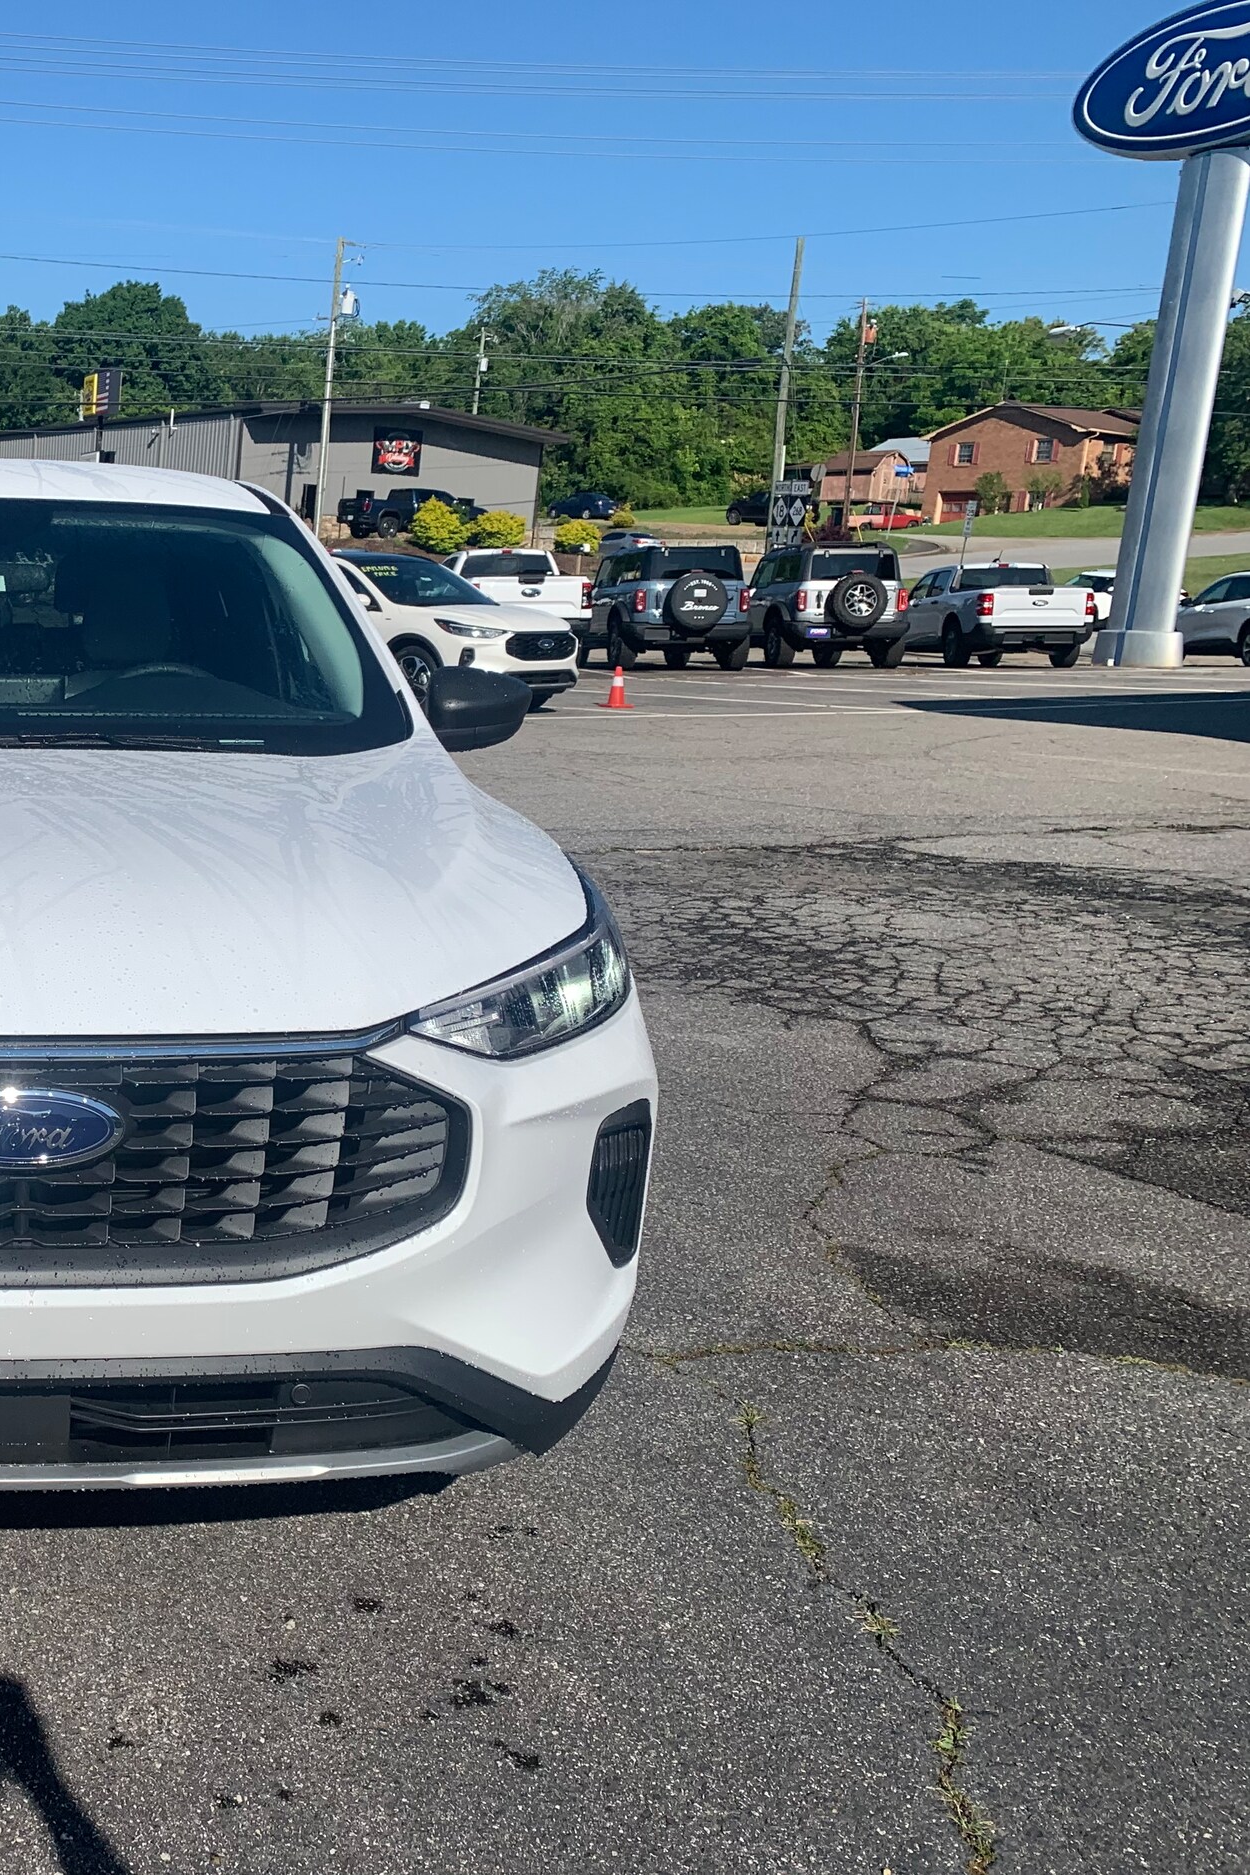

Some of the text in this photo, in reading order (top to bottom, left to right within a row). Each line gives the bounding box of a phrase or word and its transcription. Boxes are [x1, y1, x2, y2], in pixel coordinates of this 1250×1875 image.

[1124, 21, 1250, 127] For
[793, 483, 807, 493] EAST
[776, 504, 785, 518] 18
[680, 600, 720, 611] Bronco
